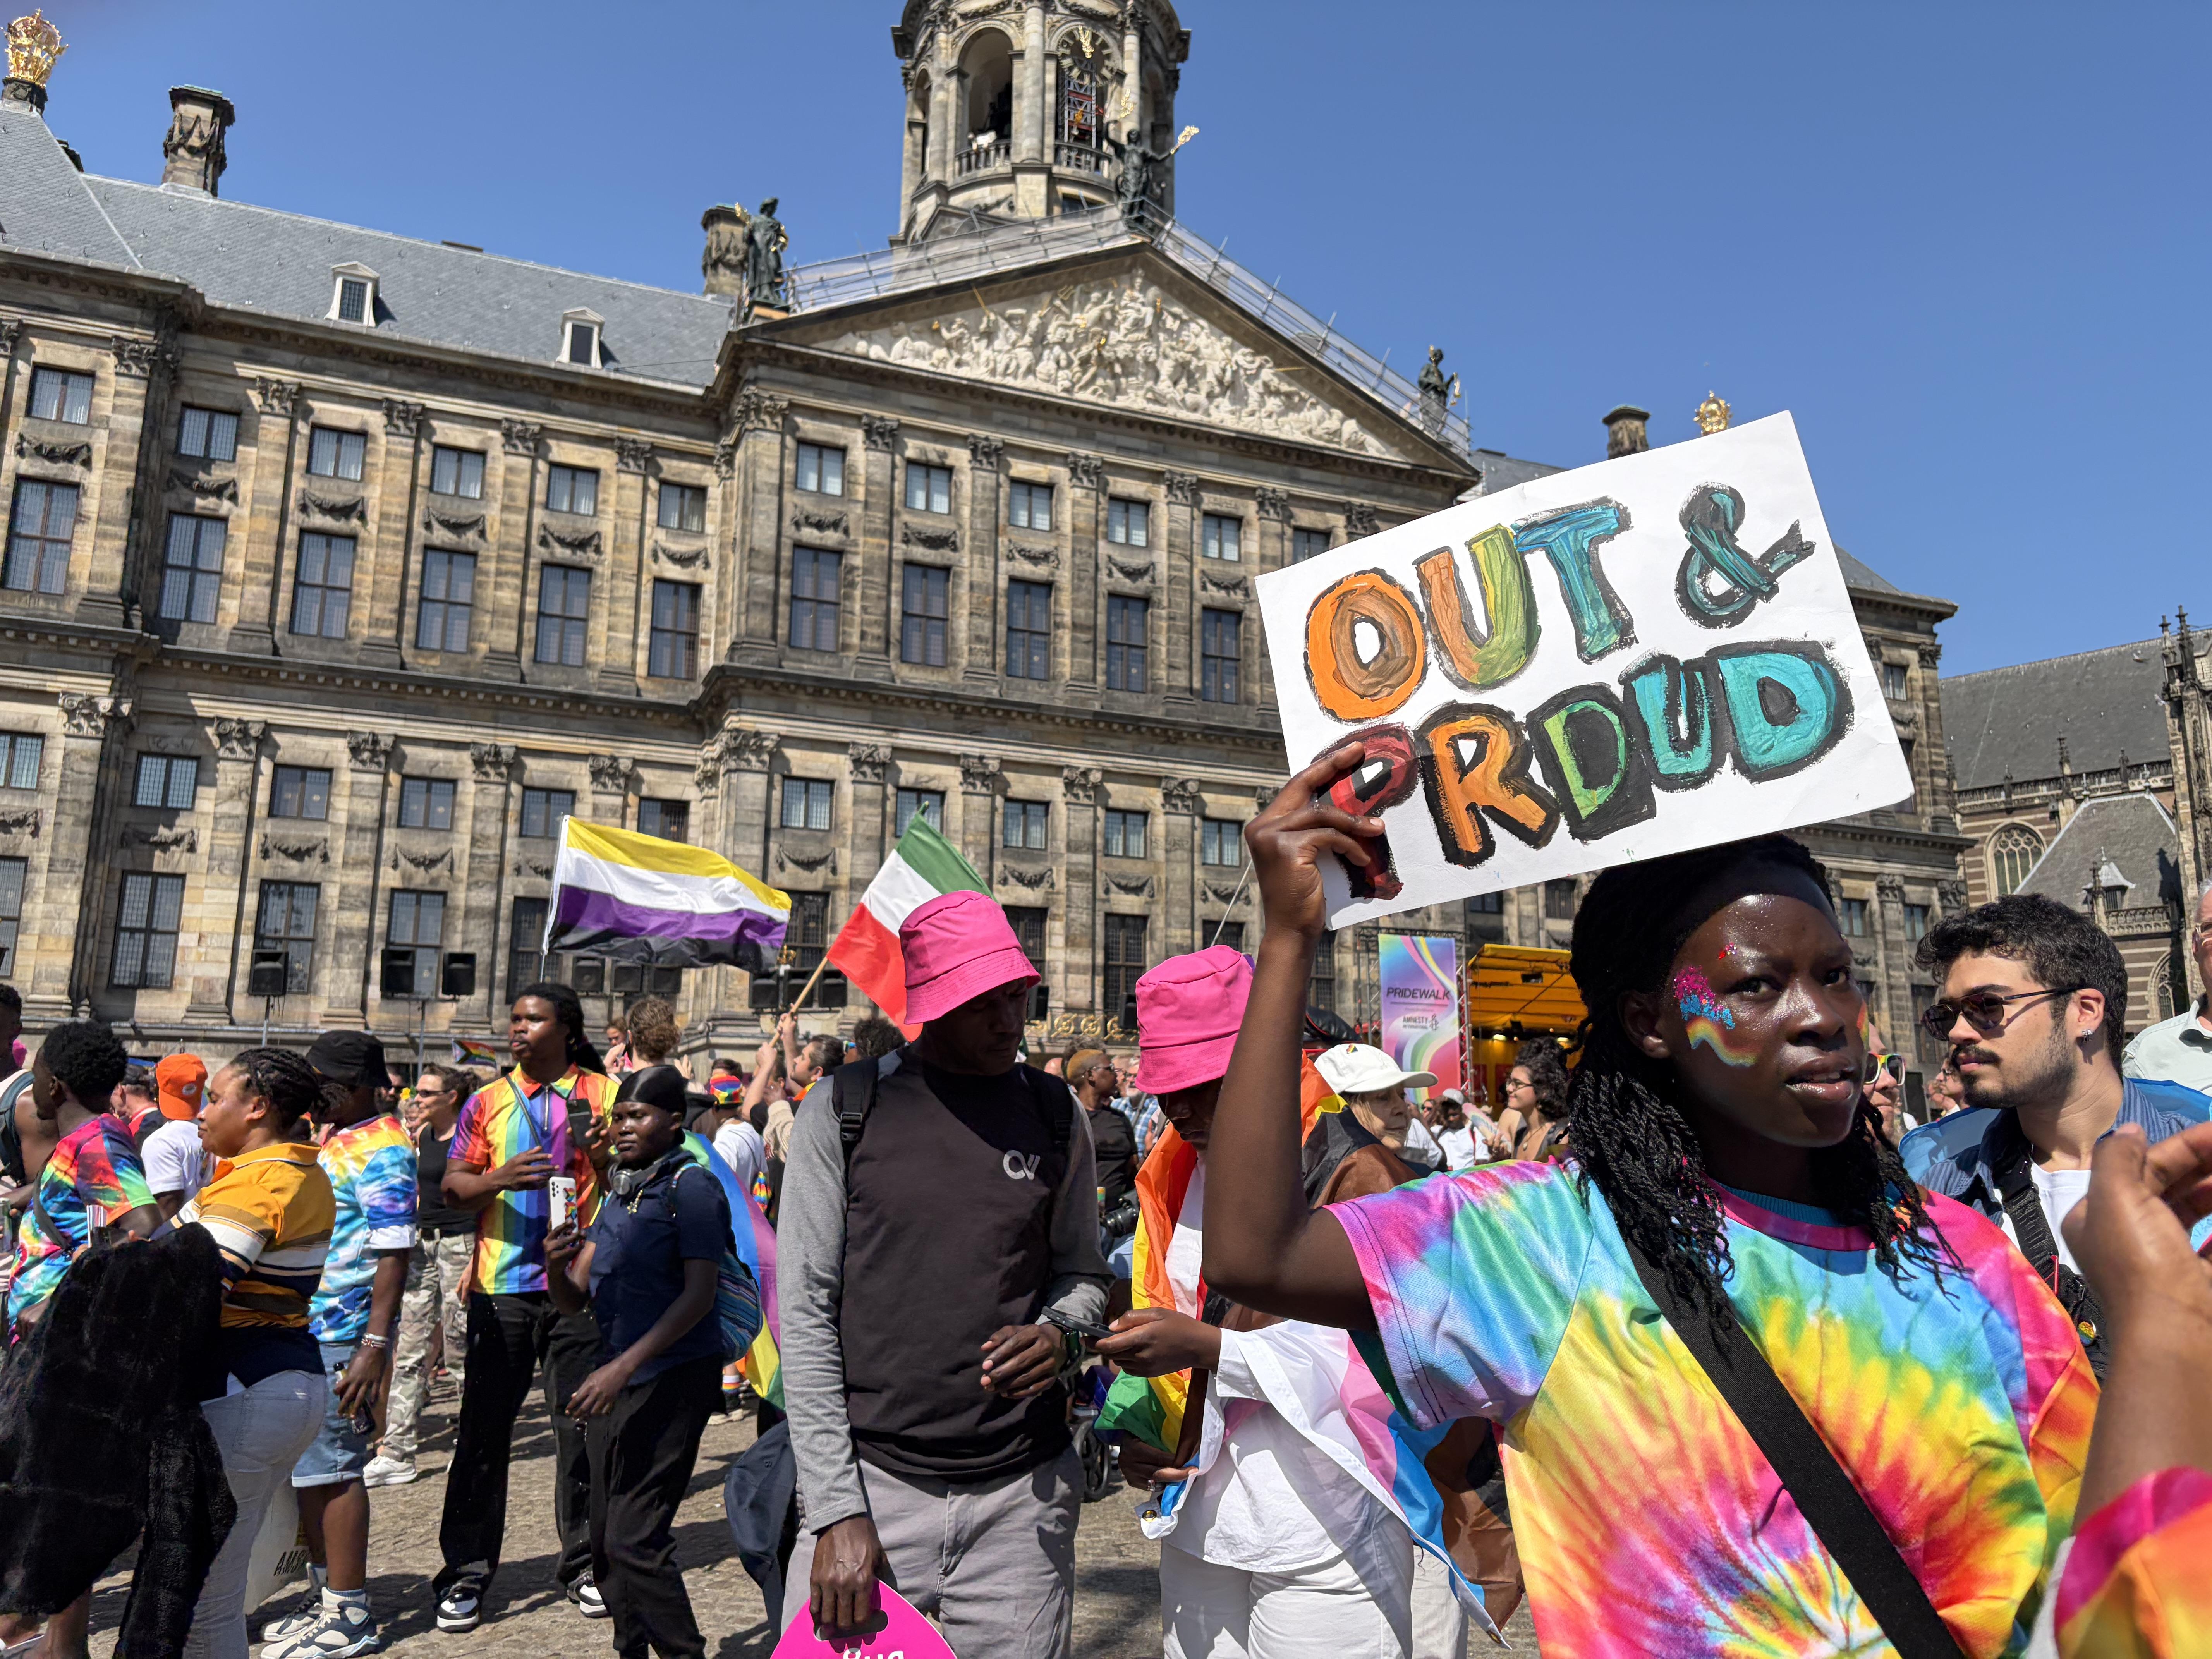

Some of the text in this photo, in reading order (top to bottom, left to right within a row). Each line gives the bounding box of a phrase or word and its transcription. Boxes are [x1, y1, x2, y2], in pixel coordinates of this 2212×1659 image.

[1304, 480, 1816, 722] OUT &
[1386, 987, 1450, 1000] PRIDEWALK
